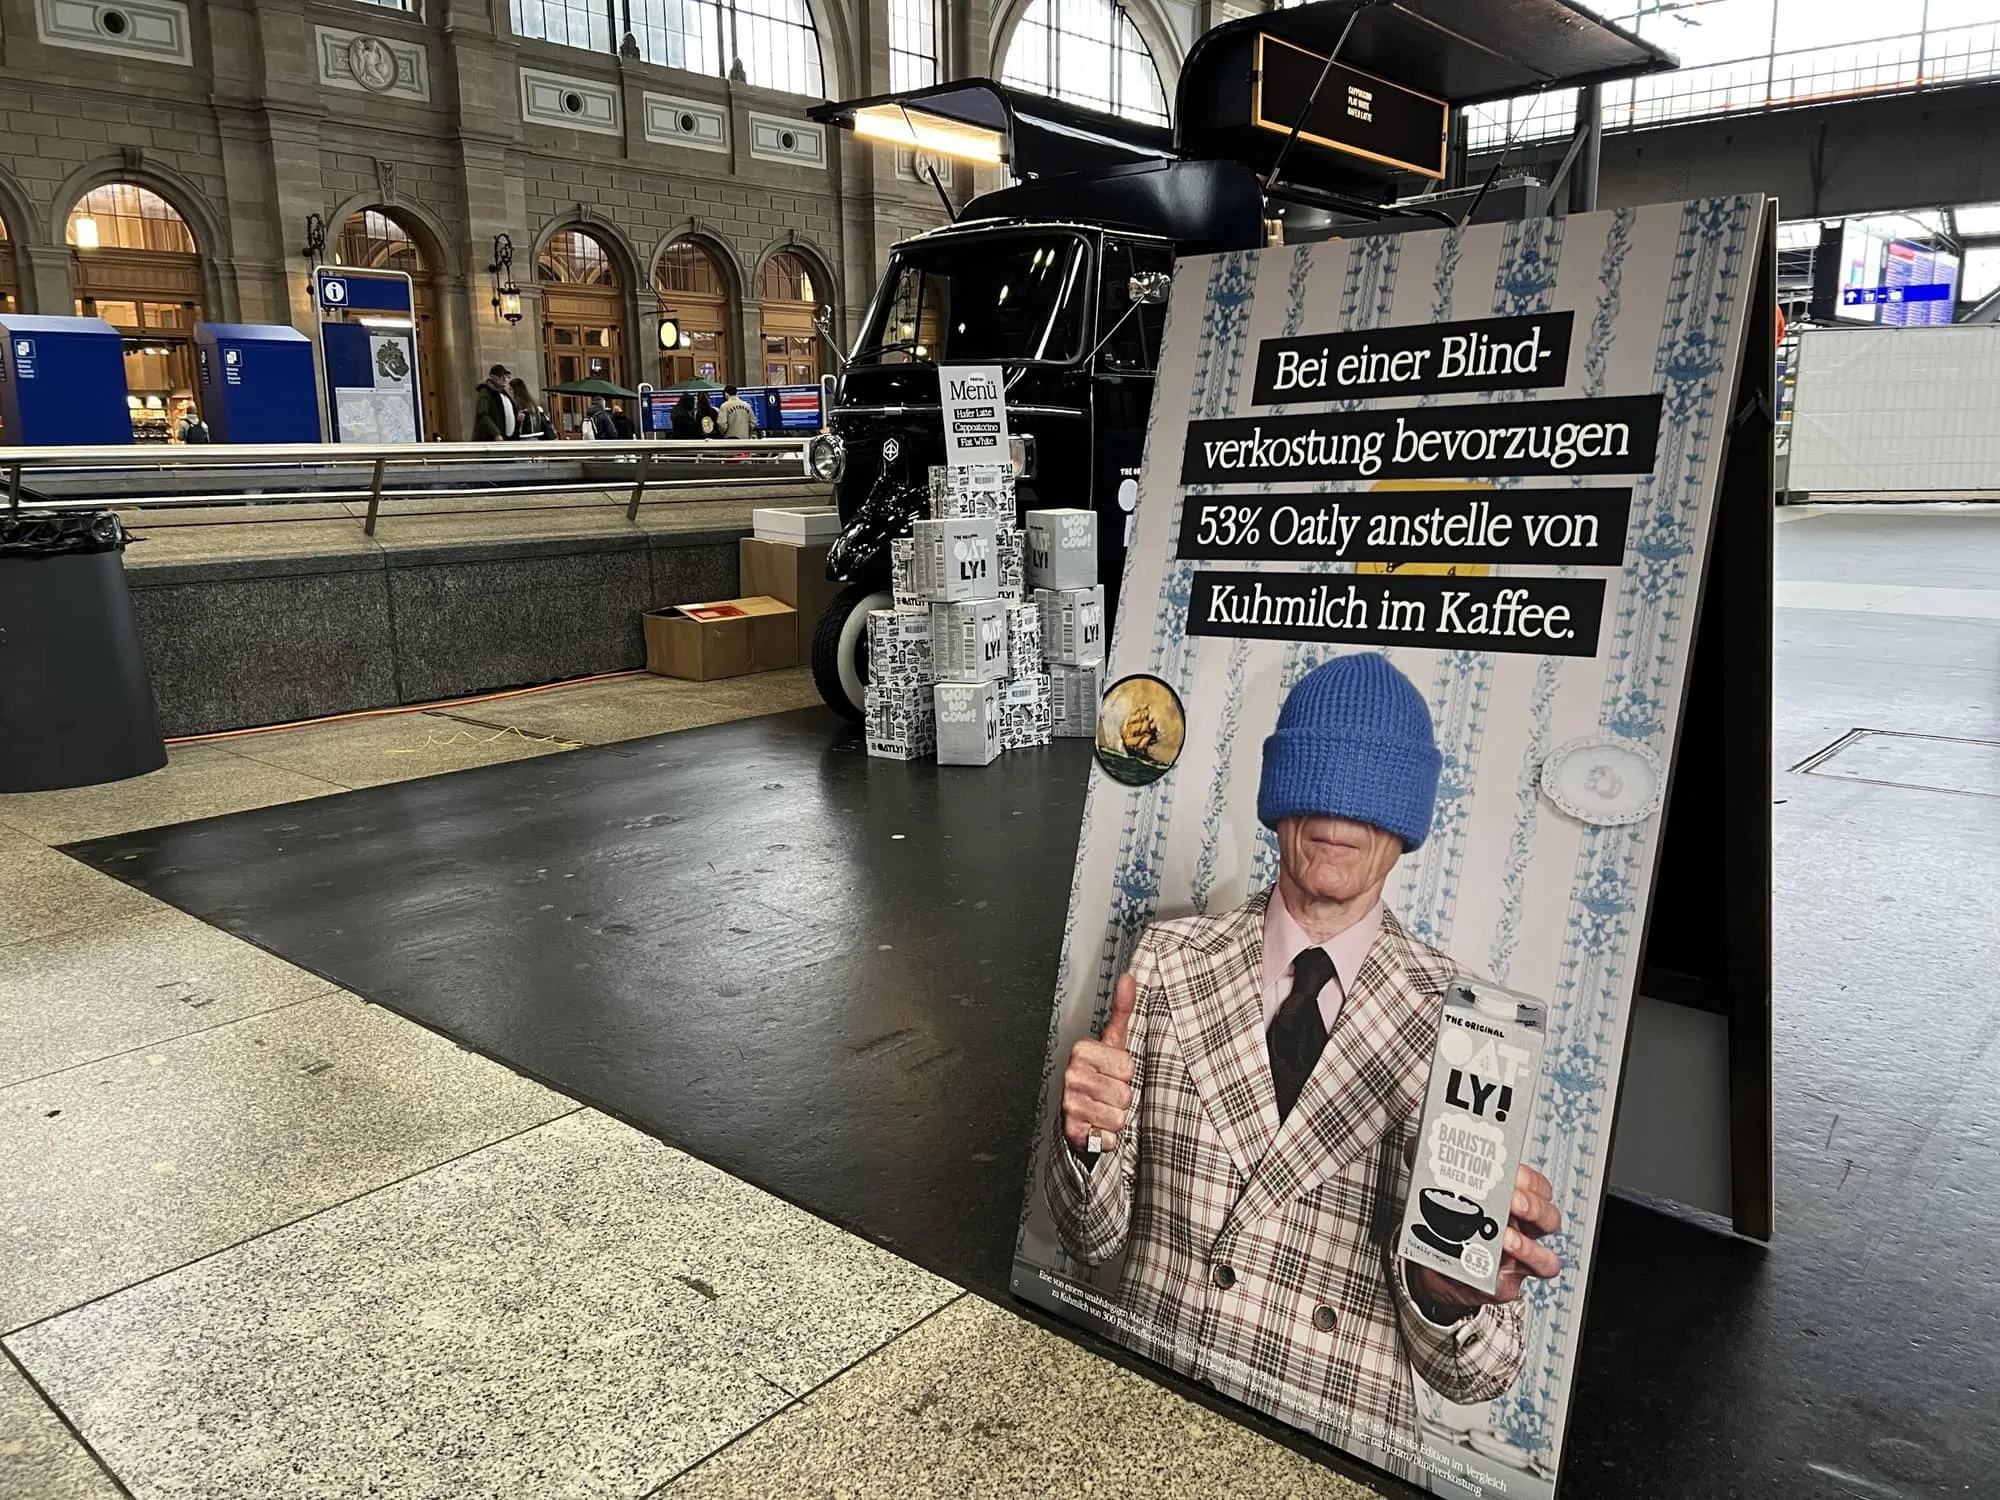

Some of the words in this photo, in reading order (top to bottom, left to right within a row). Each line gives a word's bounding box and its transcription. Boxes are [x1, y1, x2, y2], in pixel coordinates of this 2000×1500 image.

[1273, 347, 1329, 390] Bei
[1336, 344, 1431, 386] einer
[1437, 326, 1552, 379] Blind-
[949, 380, 998, 400] Menü
[957, 409, 974, 418] Hafer
[976, 408, 993, 418] Latte
[960, 438, 973, 447] Flat
[973, 437, 994, 446] White
[1203, 427, 1386, 476] verkostung
[1392, 418, 1630, 469] bevorzugen
[1062, 515, 1090, 529] WOW
[1068, 526, 1084, 538] NO
[1197, 505, 1263, 546] 53%
[1269, 503, 1362, 557] Oatly
[1366, 501, 1513, 547] anstelle
[1522, 514, 1599, 547] von
[960, 559, 986, 580] LY!
[1033, 549, 1048, 569] LY!
[1207, 583, 1369, 629] Kuhmilch
[1377, 589, 1425, 632] im
[1436, 588, 1575, 639] Kaffee.
[1084, 623, 1099, 644] LY!
[985, 639, 1000, 662] LY!
[941, 688, 974, 702] WOW
[948, 701, 967, 712] NO
[941, 709, 977, 722] COW!
[1445, 1014, 1463, 1026] THE
[1464, 1020, 1505, 1038] ORIGINAL
[1445, 1068, 1513, 1122] LY!
[1439, 1123, 1496, 1160] BARISTA
[1438, 1143, 1493, 1179] EDITION
[1440, 1164, 1466, 1184] HAFER
[1468, 1175, 1485, 1190] OAT
[1060, 1291, 1089, 1313] Kuhmilch
[1090, 1307, 1101, 1318] von
[1102, 1311, 1116, 1324] 300
[1039, 1269, 1053, 1283] Eine
[1053, 1278, 1064, 1289] von
[1064, 1283, 1084, 1297] einem
[1084, 1291, 1128, 1318] unabhängigen
[1389, 1428, 1418, 1451] Barista
[1420, 1442, 1450, 1466] Edition
[1466, 1463, 1507, 1492] Vergleich
